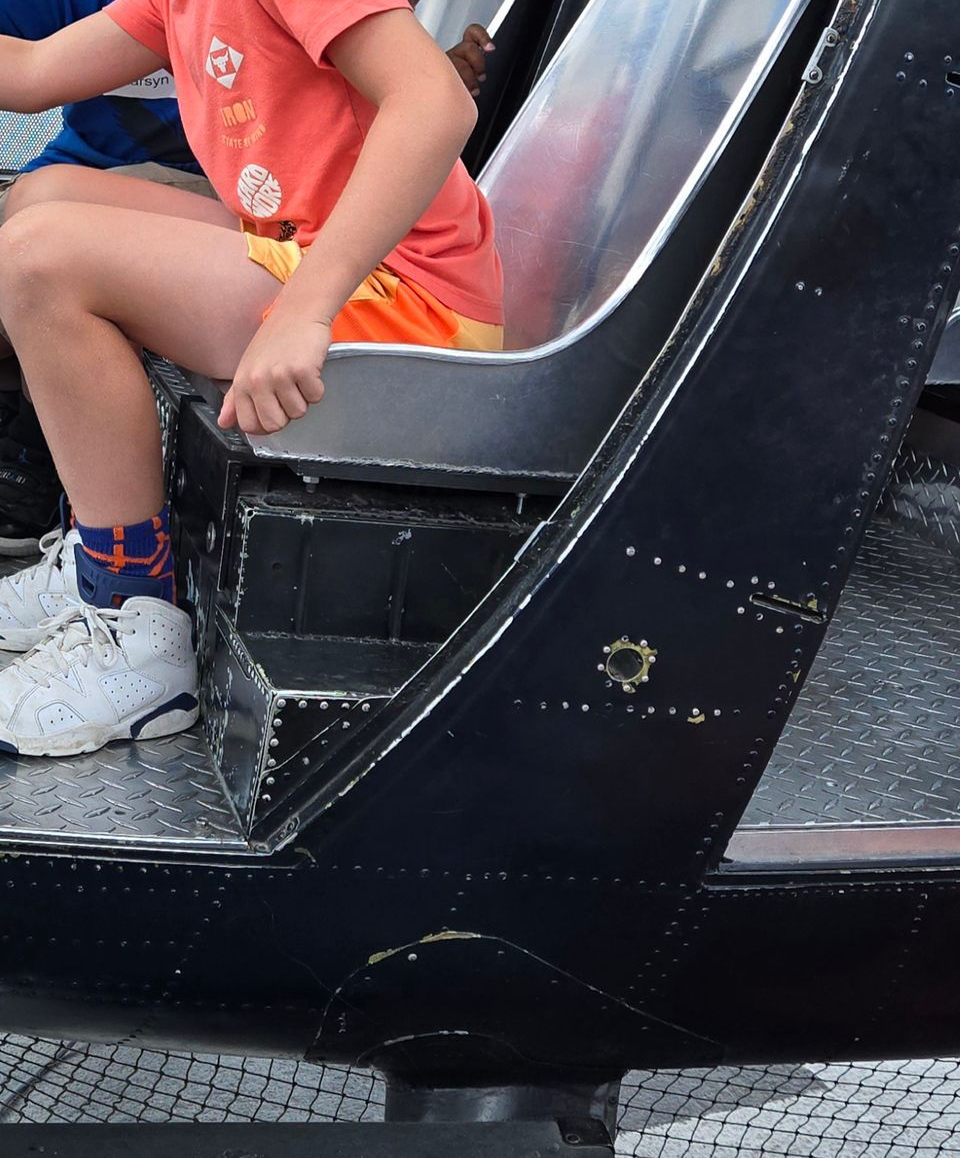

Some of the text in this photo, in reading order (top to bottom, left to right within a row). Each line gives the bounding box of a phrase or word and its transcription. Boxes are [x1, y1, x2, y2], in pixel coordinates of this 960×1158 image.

[130, 75, 170, 89] arsyn
[219, 98, 258, 128] IRON
[236, 163, 283, 219] HARD WORK
